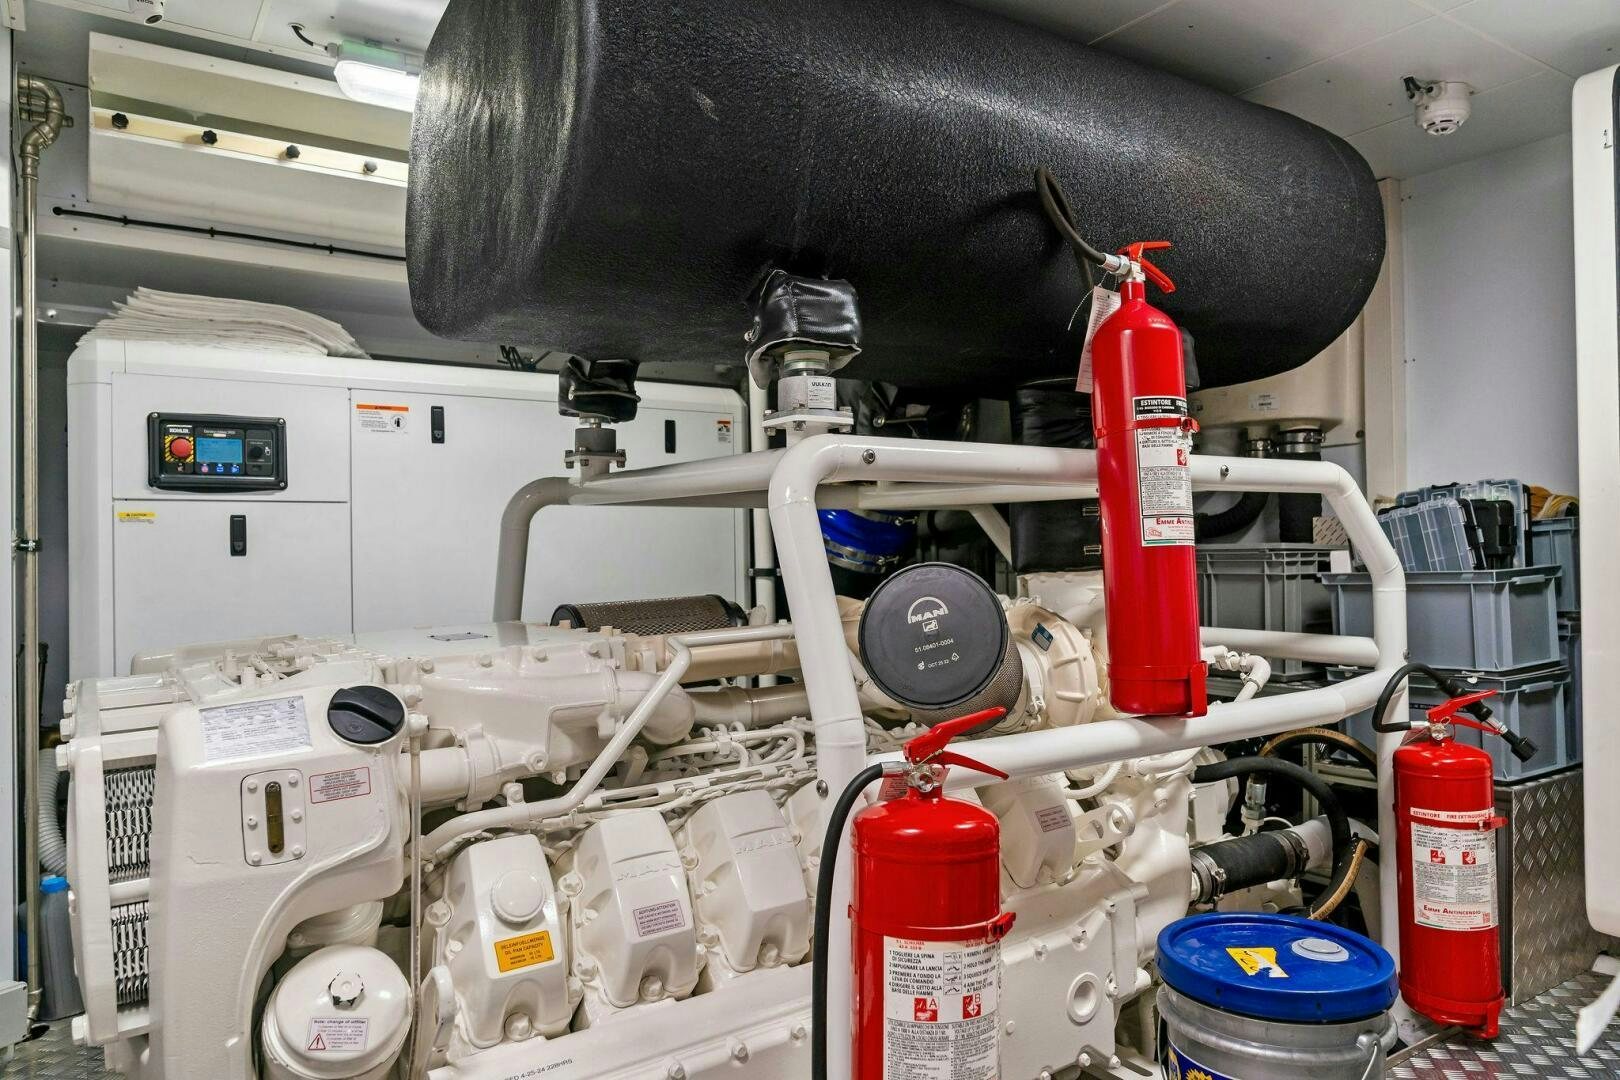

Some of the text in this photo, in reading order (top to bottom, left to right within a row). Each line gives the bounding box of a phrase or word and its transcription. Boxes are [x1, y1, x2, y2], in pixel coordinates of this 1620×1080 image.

[911, 608, 944, 623] MAN
[975, 994, 980, 1003] B
[929, 999, 937, 1008] A
